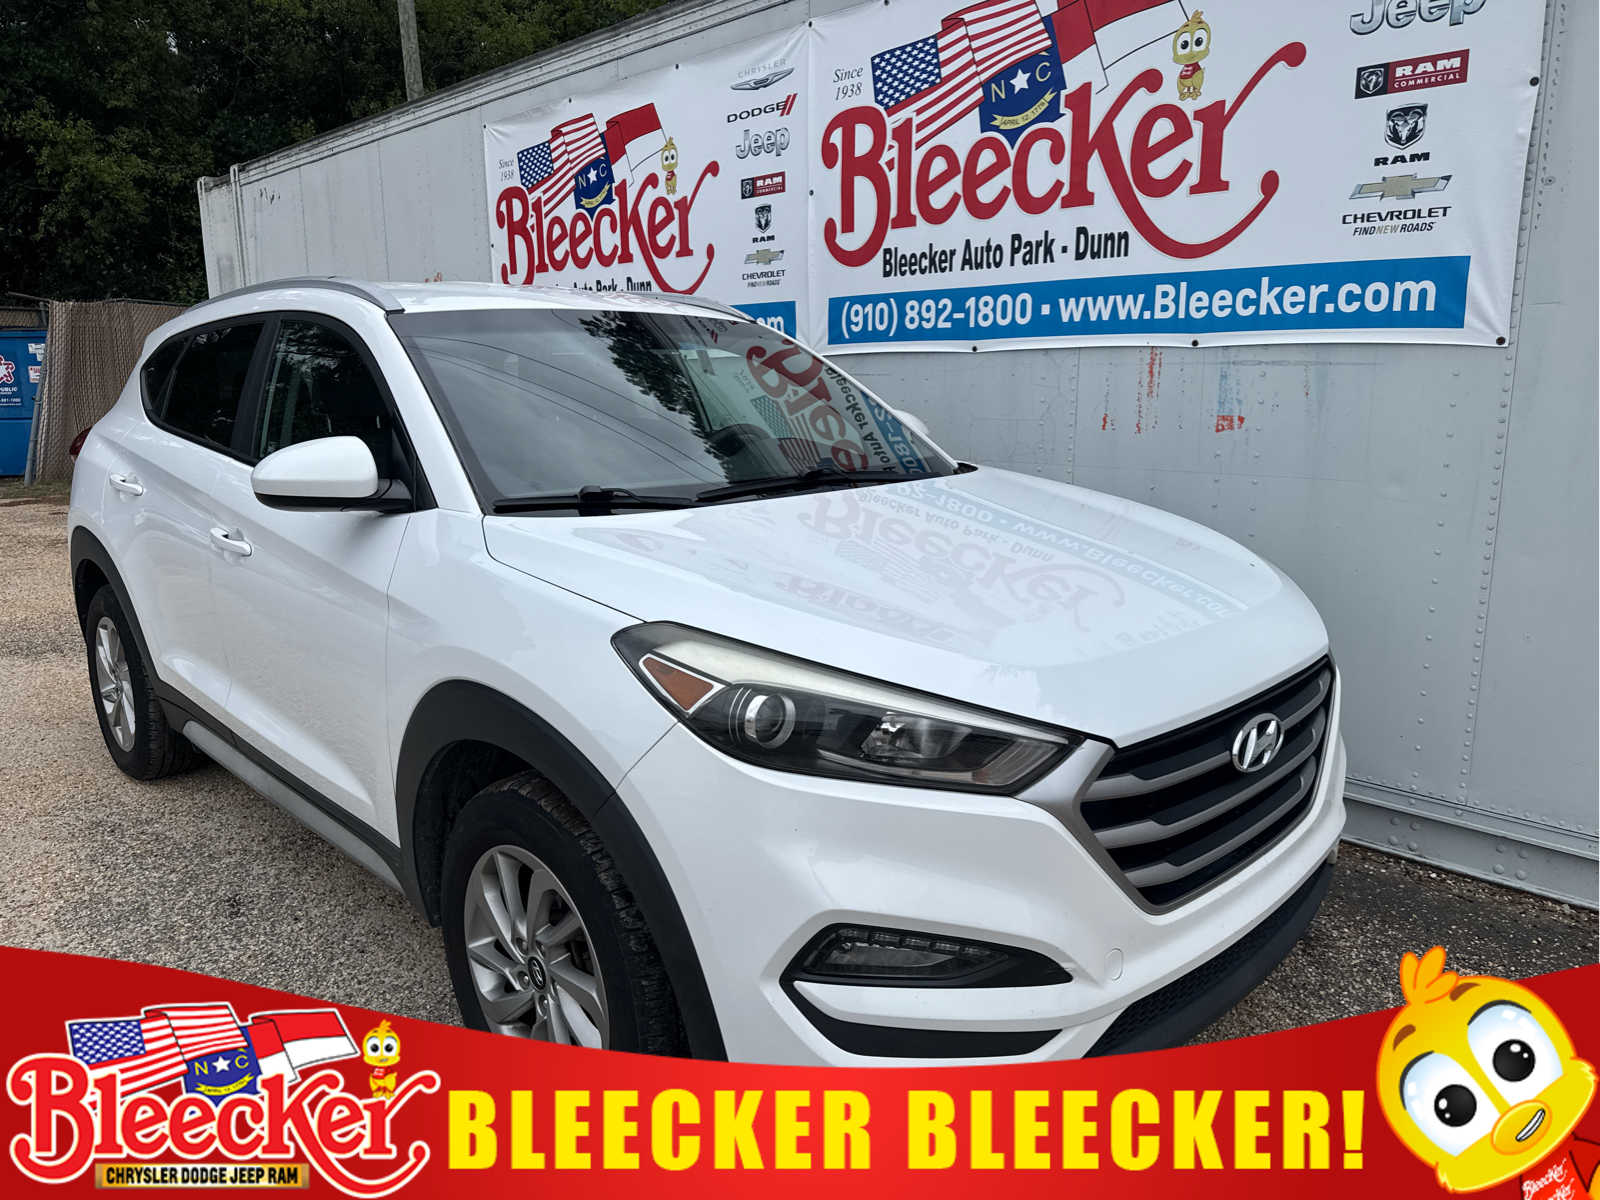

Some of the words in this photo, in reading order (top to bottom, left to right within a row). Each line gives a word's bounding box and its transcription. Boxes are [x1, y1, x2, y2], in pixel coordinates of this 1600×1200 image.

[1350, 0, 1486, 35] Jeep
[833, 67, 863, 83] Since
[1395, 57, 1462, 77] RAM
[1393, 73, 1461, 89] COMMERCIAL
[835, 82, 862, 101] 1938
[727, 100, 787, 123] DODGE
[736, 127, 790, 159] Jeep
[1373, 151, 1430, 167] RAM
[756, 176, 783, 187] RAM
[1341, 206, 1452, 225] CHEVROLET
[752, 235, 775, 244] RAM
[882, 243, 956, 278] Bleecker
[960, 238, 1004, 272] Auto
[1010, 230, 1055, 267] Park
[1075, 226, 1130, 261] Dunn
[742, 269, 786, 281] CHEVROLET
[841, 298, 898, 339] (910)
[904, 292, 1033, 330] 892-1800
[1058, 277, 1436, 323] www.Bleecker.com
